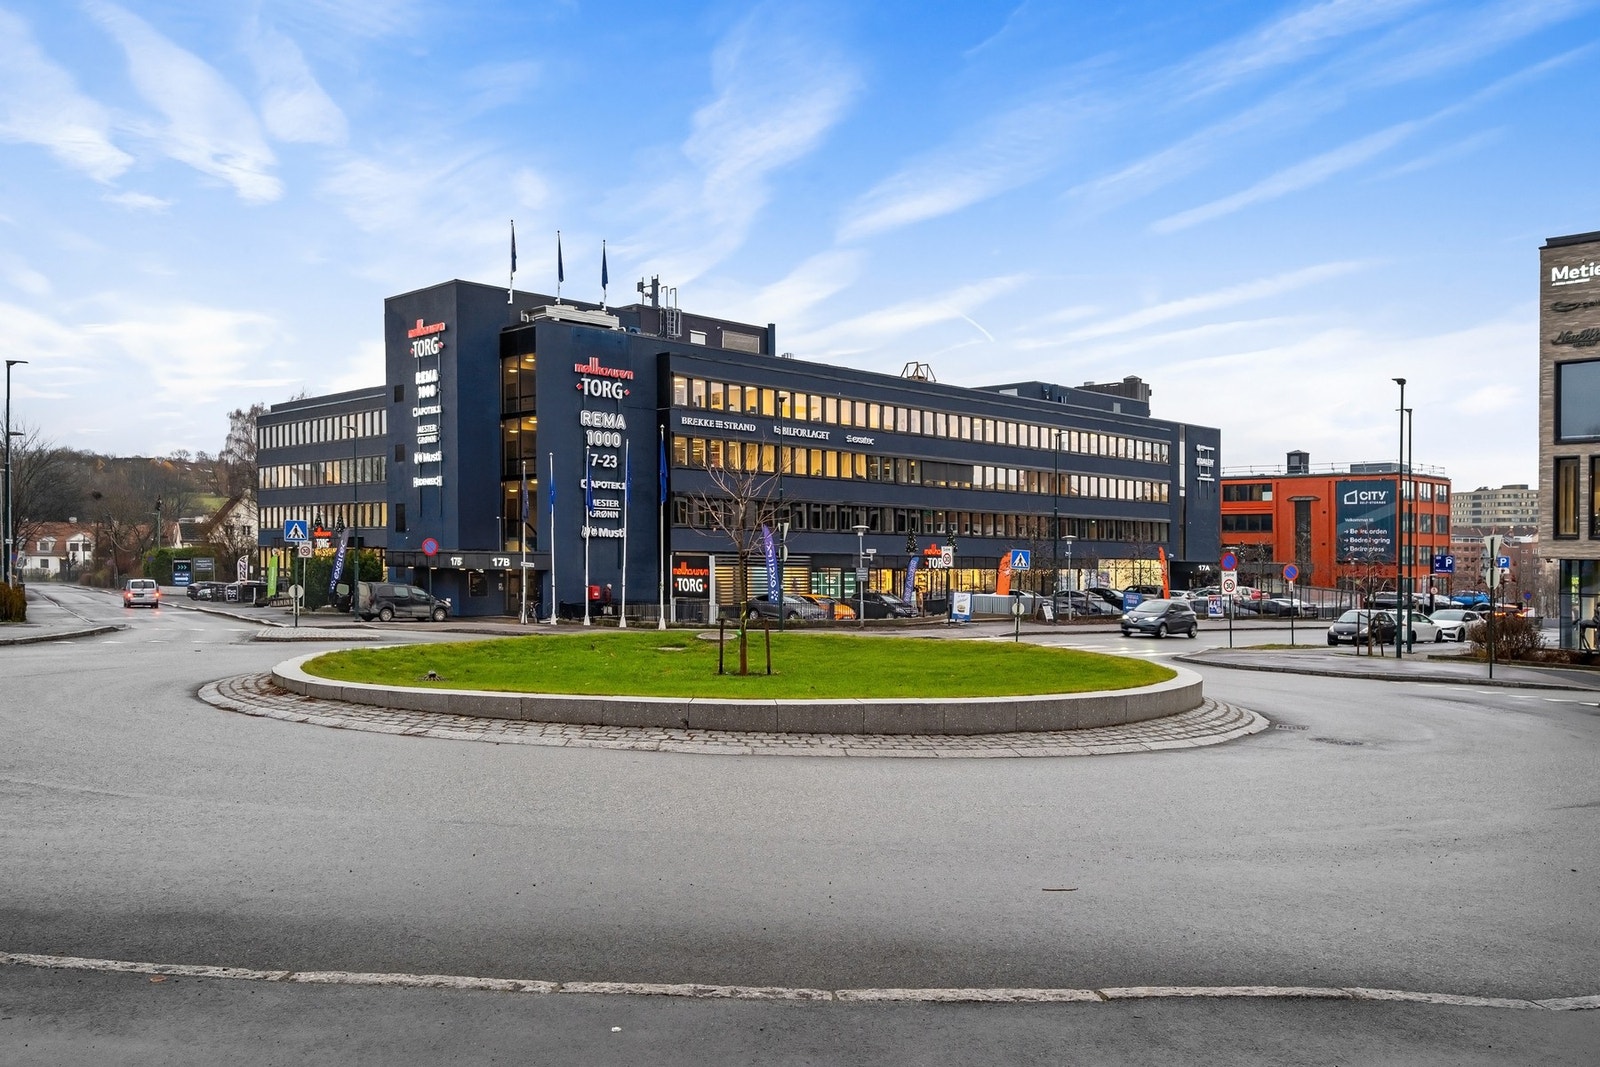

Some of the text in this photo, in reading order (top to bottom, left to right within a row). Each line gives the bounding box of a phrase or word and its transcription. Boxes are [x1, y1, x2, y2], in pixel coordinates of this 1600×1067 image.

[412, 337, 439, 358] TORG
[580, 378, 623, 400] TORG
[580, 410, 626, 430] REMA
[681, 416, 757, 432] BREKKE STRAND
[586, 429, 622, 448] 1000
[782, 426, 830, 440] BILFORLAGET
[590, 453, 618, 468] 7-23
[1359, 491, 1386, 501] CITY
[492, 557, 511, 567] 17B
[1445, 559, 1452, 567] P
[1500, 558, 1507, 566] P
[677, 578, 704, 593] TORG
